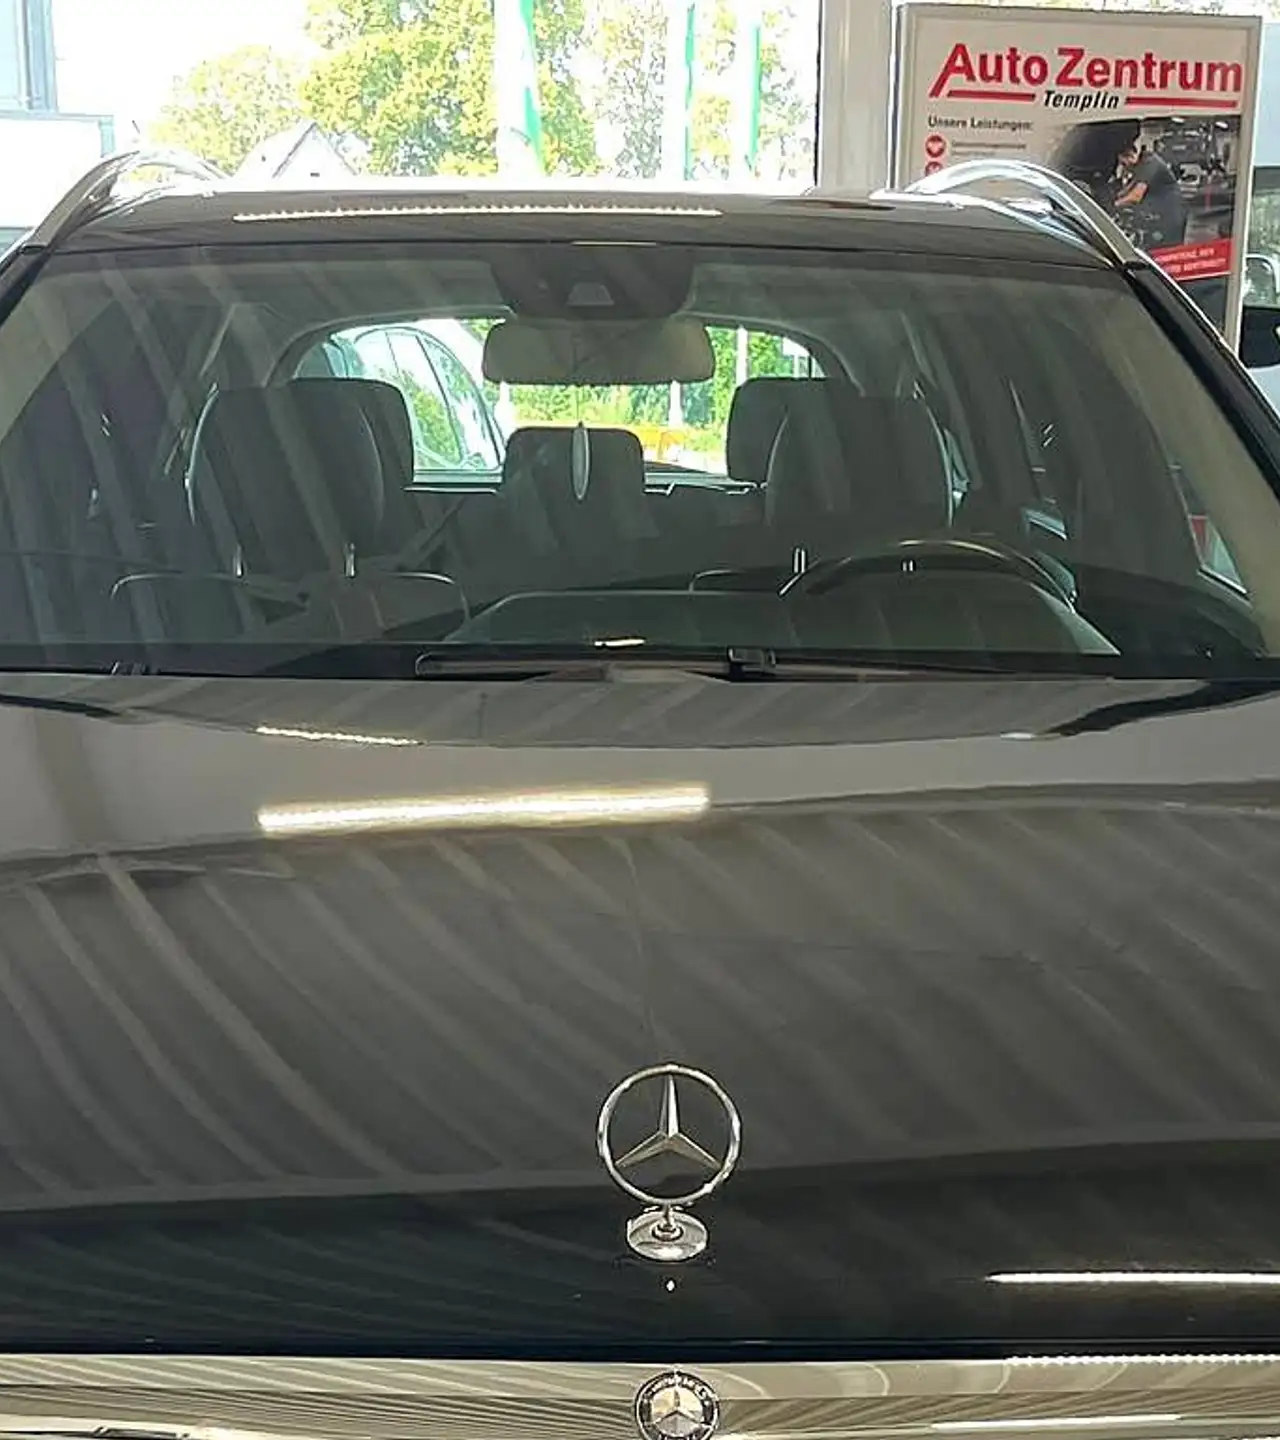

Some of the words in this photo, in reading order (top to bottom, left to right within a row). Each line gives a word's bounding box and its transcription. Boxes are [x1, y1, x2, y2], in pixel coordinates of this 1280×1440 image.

[928, 43, 1049, 98] Auto
[1055, 47, 1243, 92] Zentrum
[1043, 90, 1120, 113] Templin
